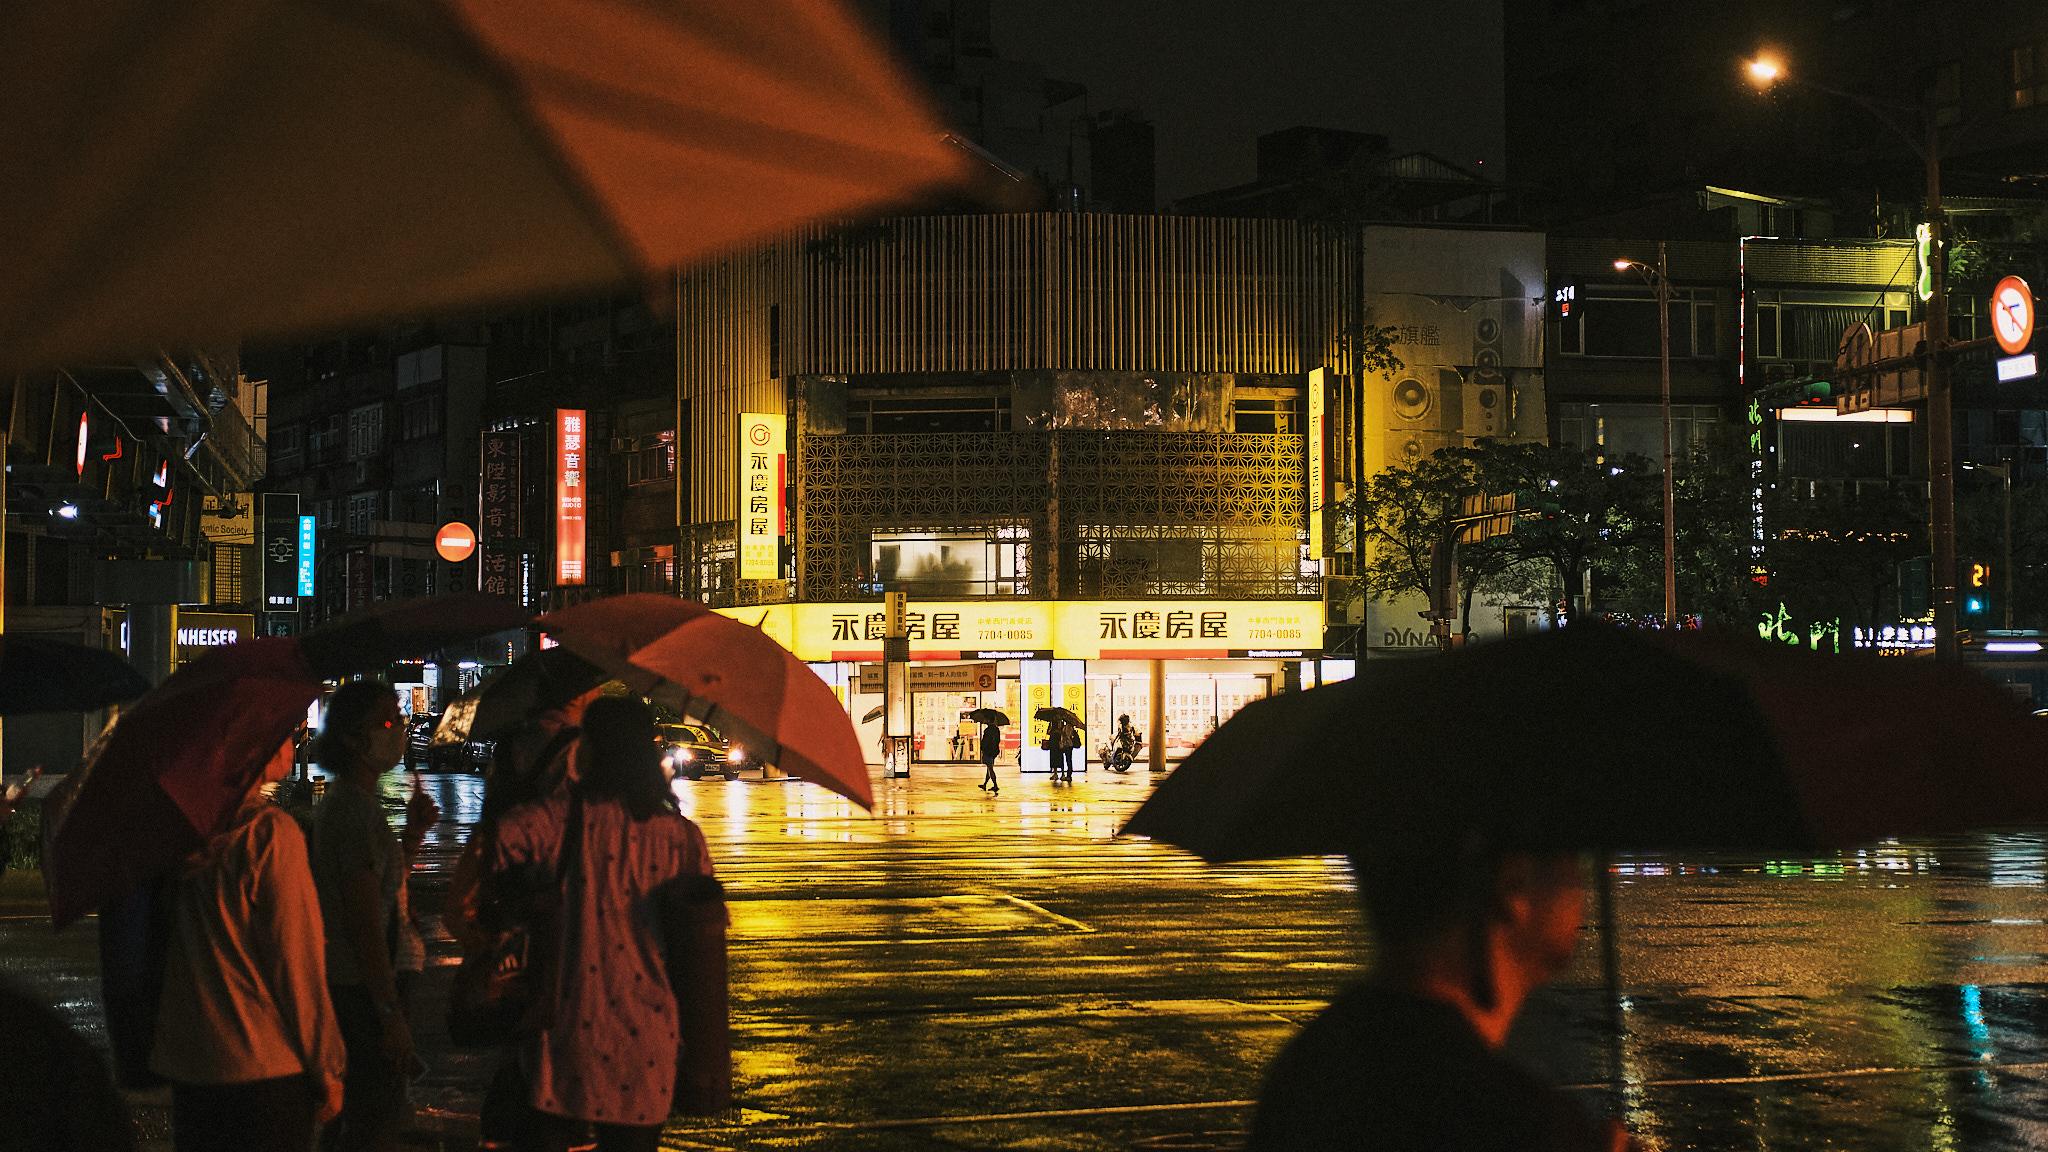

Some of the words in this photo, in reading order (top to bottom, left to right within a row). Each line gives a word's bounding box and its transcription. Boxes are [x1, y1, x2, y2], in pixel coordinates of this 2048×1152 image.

[750, 452, 769, 536] 永慶房屋
[485, 438, 507, 596] 東陞影音活館
[221, 524, 248, 536] Society
[832, 613, 960, 641] 永慶房屋
[978, 629, 1033, 640] 7704-0085
[1100, 611, 1228, 639] 永慶房屋
[1248, 629, 1301, 640] 7704-0085
[1384, 627, 1442, 646] DYNA
